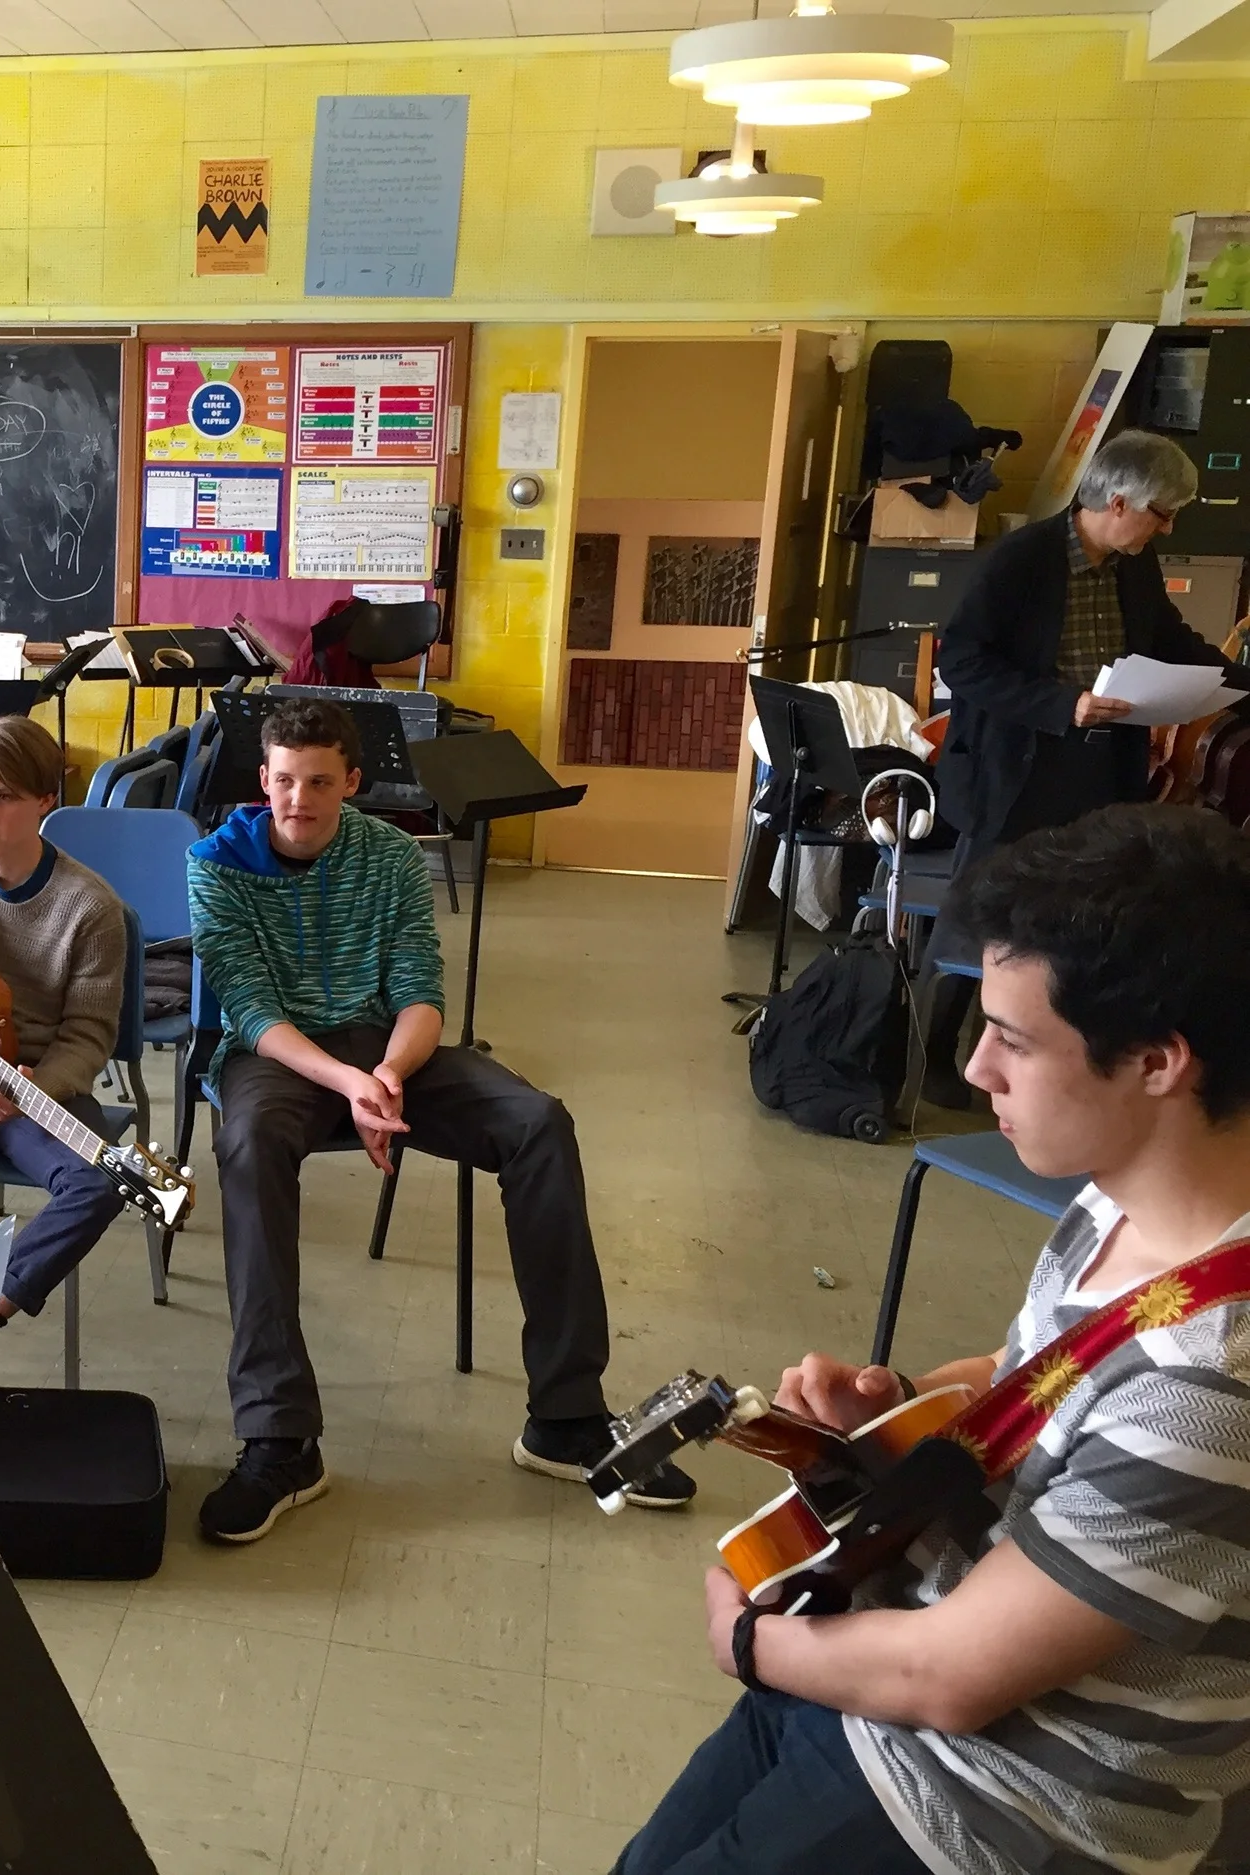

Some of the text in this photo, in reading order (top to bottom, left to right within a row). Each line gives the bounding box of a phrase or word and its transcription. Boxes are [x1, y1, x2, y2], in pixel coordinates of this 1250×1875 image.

[205, 173, 264, 188] CHARLIE
[205, 188, 263, 203] BROWN
[208, 394, 226, 402] THE
[147, 470, 191, 478] INTERVALS
